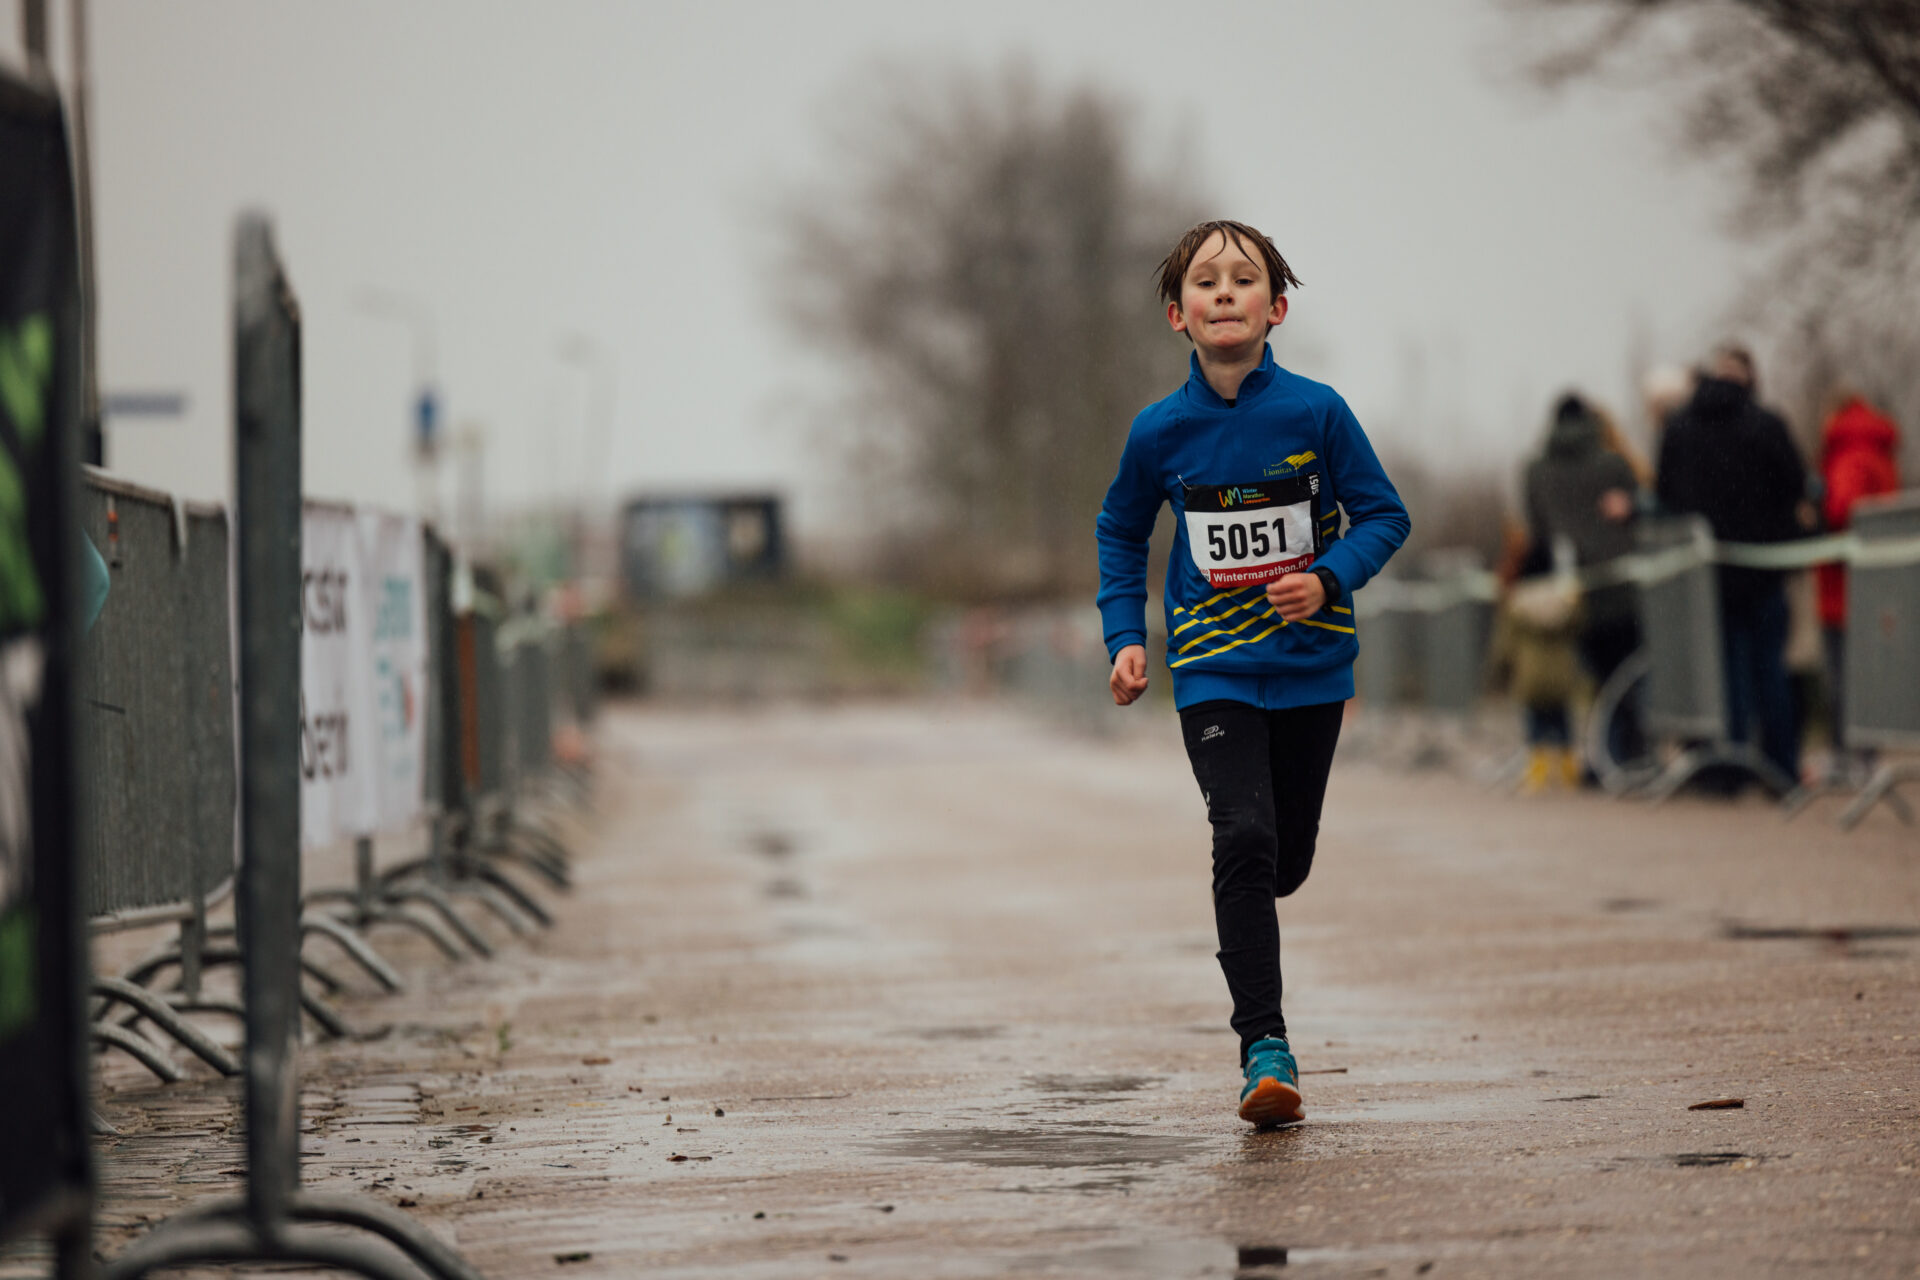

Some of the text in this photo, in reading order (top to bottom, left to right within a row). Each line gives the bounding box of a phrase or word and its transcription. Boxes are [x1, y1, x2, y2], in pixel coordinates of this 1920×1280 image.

[1308, 474, 1320, 496] 5051
[1207, 517, 1288, 562] 5051
[1213, 557, 1309, 583] Wintermarathon.frl
